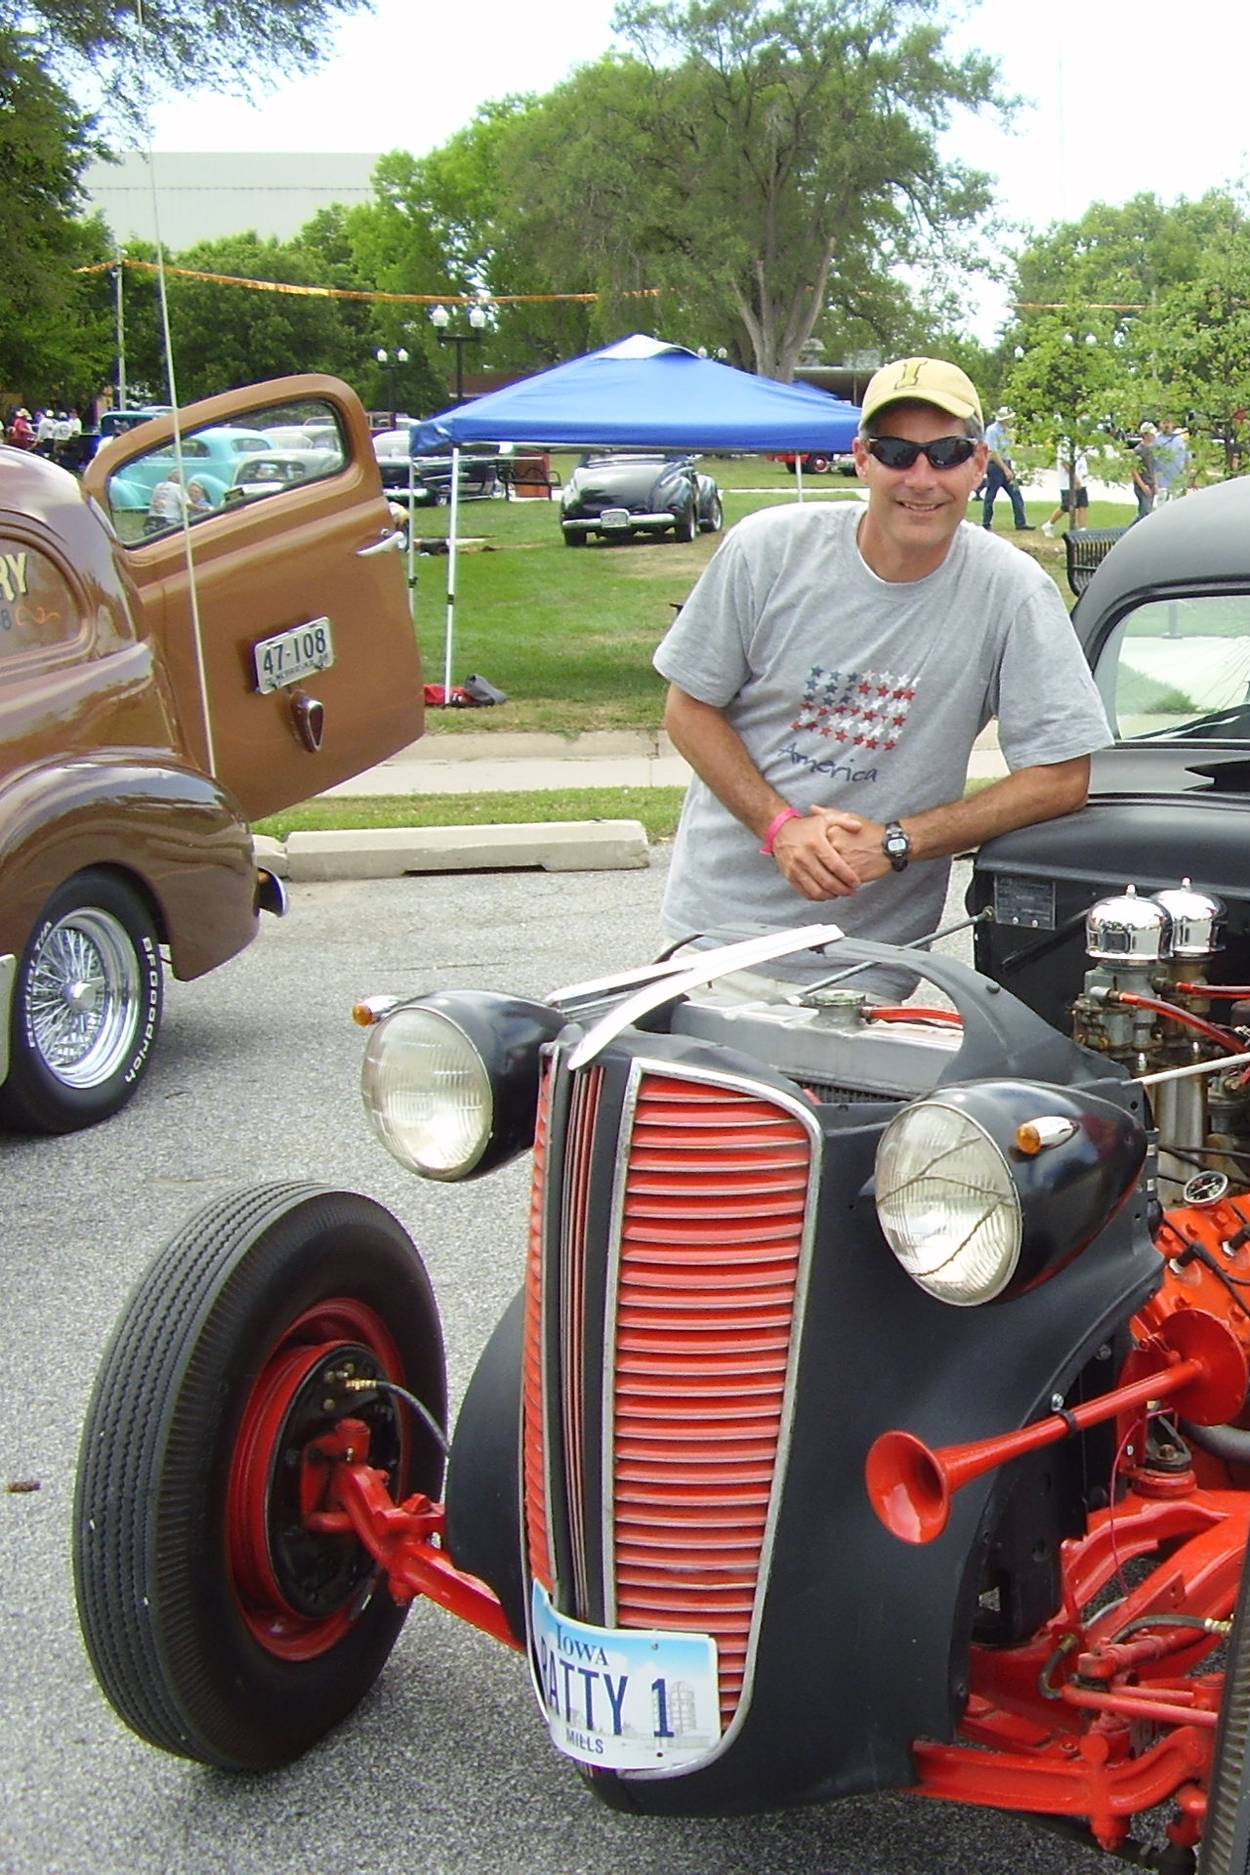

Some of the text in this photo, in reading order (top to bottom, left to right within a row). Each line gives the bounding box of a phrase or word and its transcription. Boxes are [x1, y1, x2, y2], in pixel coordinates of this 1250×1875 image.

[263, 628, 326, 674] 47-108
[778, 742, 879, 783] America
[651, 1677, 675, 1738] 1
[566, 1727, 604, 1754] MILLS
